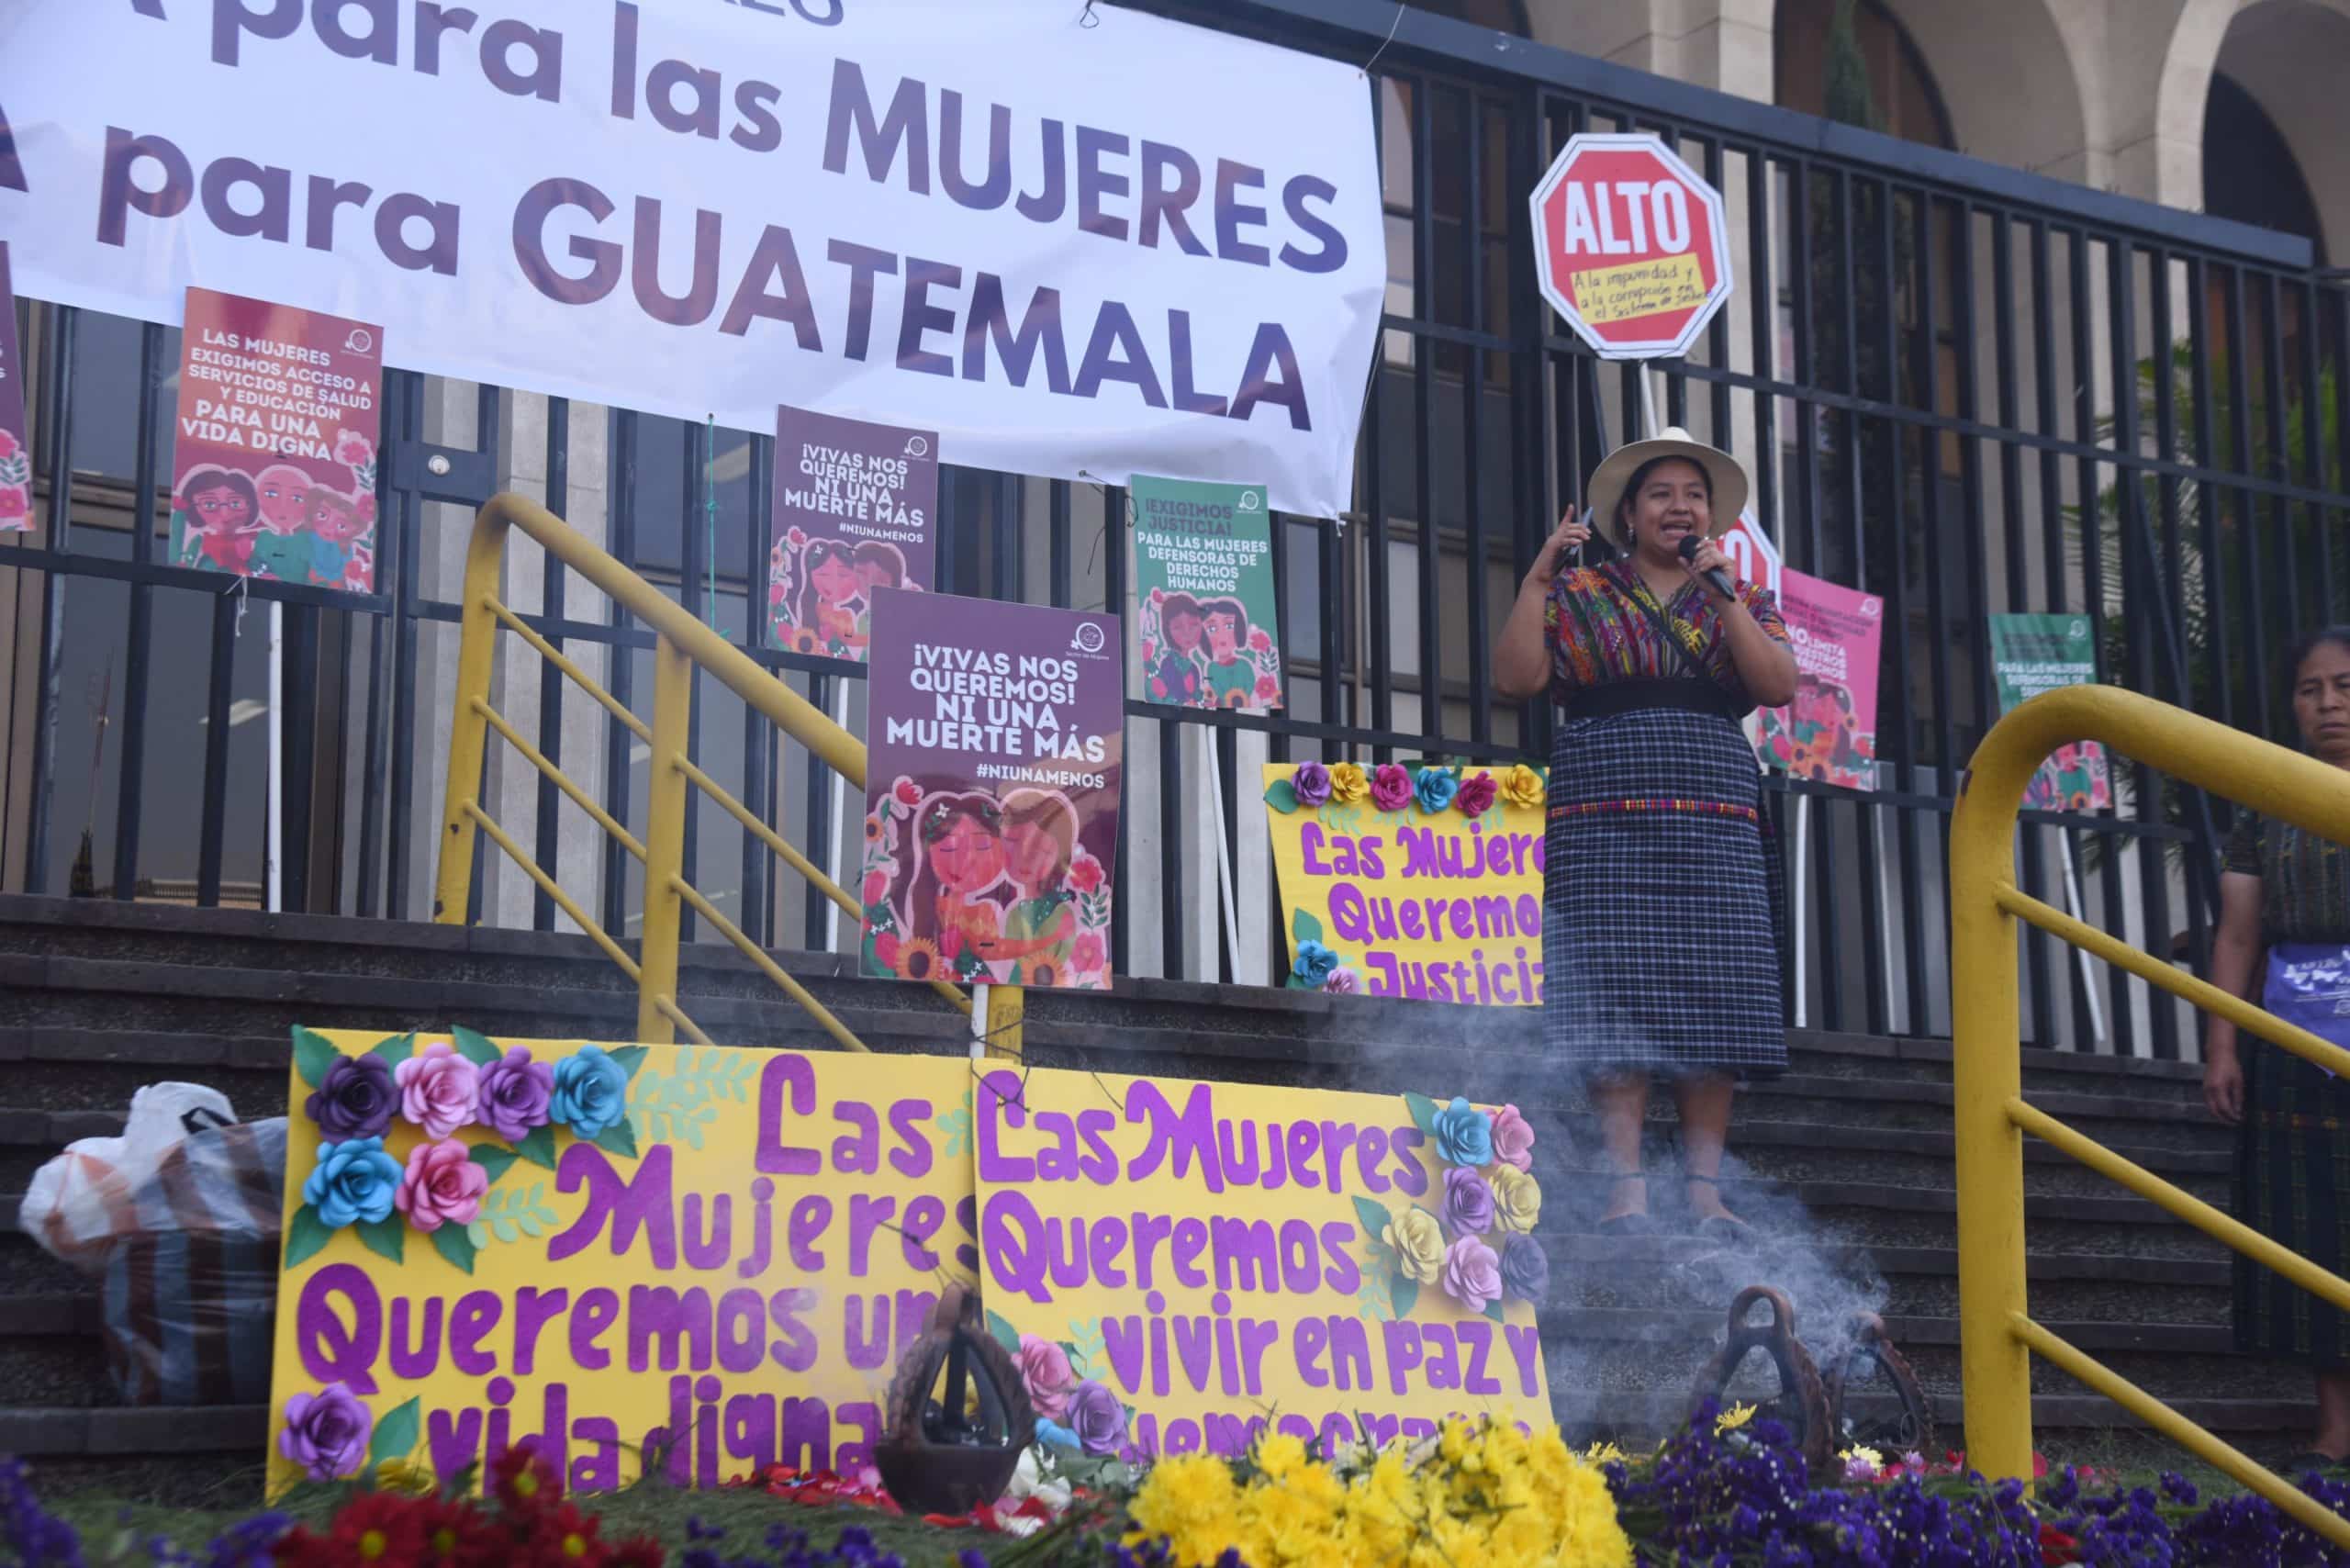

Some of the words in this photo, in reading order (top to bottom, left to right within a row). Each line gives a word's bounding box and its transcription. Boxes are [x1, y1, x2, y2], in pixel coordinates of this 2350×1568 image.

[211, 0, 563, 103] para
[610, 0, 782, 152] las
[822, 58, 1348, 274] MUJERES
[1564, 179, 1691, 253] ALTO
[96, 125, 461, 276] para
[512, 177, 1313, 432] GUATEMALA
[1588, 269, 1601, 288] la
[1581, 299, 1589, 309] a
[1592, 290, 1604, 307] la
[203, 329, 239, 349] LAS
[244, 337, 330, 366] MUJERES
[188, 364, 286, 397] SERVICIOS
[292, 384, 314, 398] DE
[318, 389, 372, 409] SALUD
[190, 347, 280, 375] EXIGIMOS
[285, 366, 355, 391] ACCESO
[359, 381, 371, 394] A
[219, 386, 231, 399] Y
[181, 417, 244, 445] VIDA
[252, 431, 331, 460] DIGNA
[196, 399, 263, 428] PARA
[270, 413, 320, 439] UNA
[800, 459, 905, 489] QUEREMOS!
[802, 443, 863, 468] ¡VIVAS
[868, 456, 908, 475] NOS
[785, 488, 867, 521] MUERTE
[875, 501, 924, 526] MÁS
[815, 477, 840, 497] NI
[847, 484, 893, 505] UNA
[838, 521, 923, 543] #NIUNAMENOS
[1137, 532, 1172, 547] PARA
[1176, 535, 1201, 549] LAS
[1204, 538, 1268, 553] MUJERES
[1148, 516, 1231, 536] JUSTICIA!
[1149, 547, 1236, 566] DEFENSORAS
[1239, 554, 1257, 566] DE
[1167, 562, 1239, 579] DERECHOS
[1168, 576, 1237, 592] HUMANOS
[914, 644, 1011, 676] ¡VIVAS
[1019, 655, 1079, 682] NOS
[910, 667, 1076, 706] QUEREMOS!
[935, 693, 976, 723] NI
[987, 699, 1060, 732] UNA
[886, 716, 1023, 756] MUERTE
[1034, 723, 1106, 763] MÁS
[976, 764, 1104, 789] #NIUNAMENOS
[1301, 822, 1385, 879] Las
[1397, 823, 1545, 879] Mujere
[1327, 882, 1543, 946] Queremo
[754, 1053, 934, 1179] Las
[978, 1070, 1120, 1185] Las
[1125, 1080, 1428, 1197] Mujeres
[982, 1190, 1361, 1303] Queremos
[296, 1262, 819, 1396] Queremos
[1102, 1290, 1279, 1396] vivir
[1292, 1314, 1373, 1391] en
